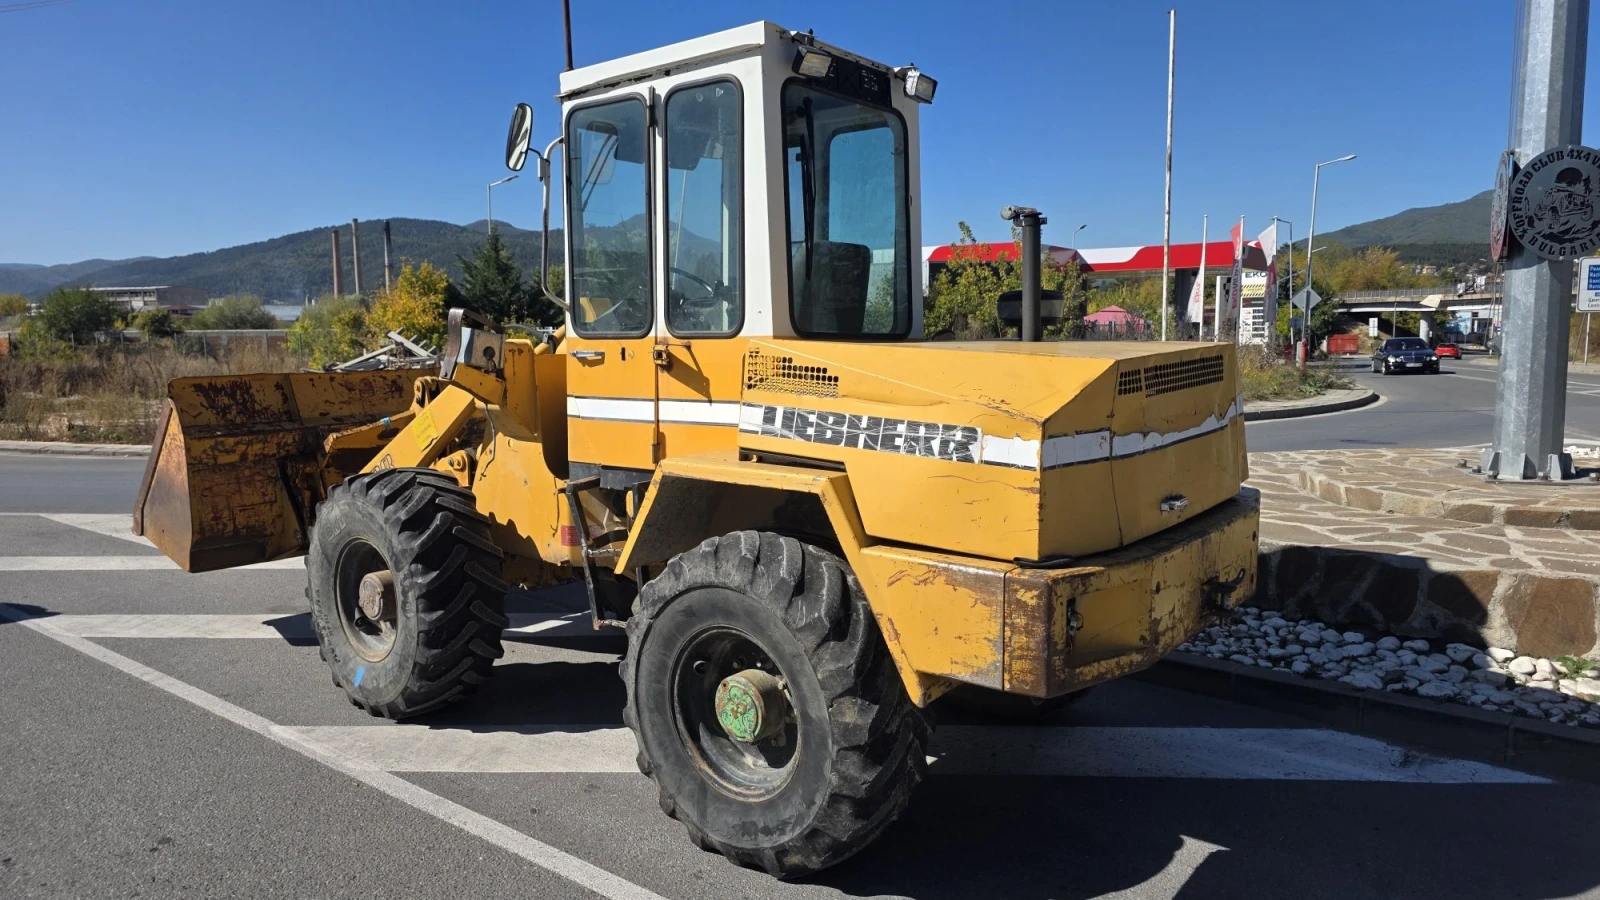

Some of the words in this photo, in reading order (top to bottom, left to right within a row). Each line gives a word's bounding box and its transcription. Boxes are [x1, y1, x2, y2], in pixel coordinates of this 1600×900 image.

[1512, 170, 1534, 228] OFFROAD
[1531, 150, 1565, 172] CLUB
[760, 405, 979, 464] LIEBHERR
